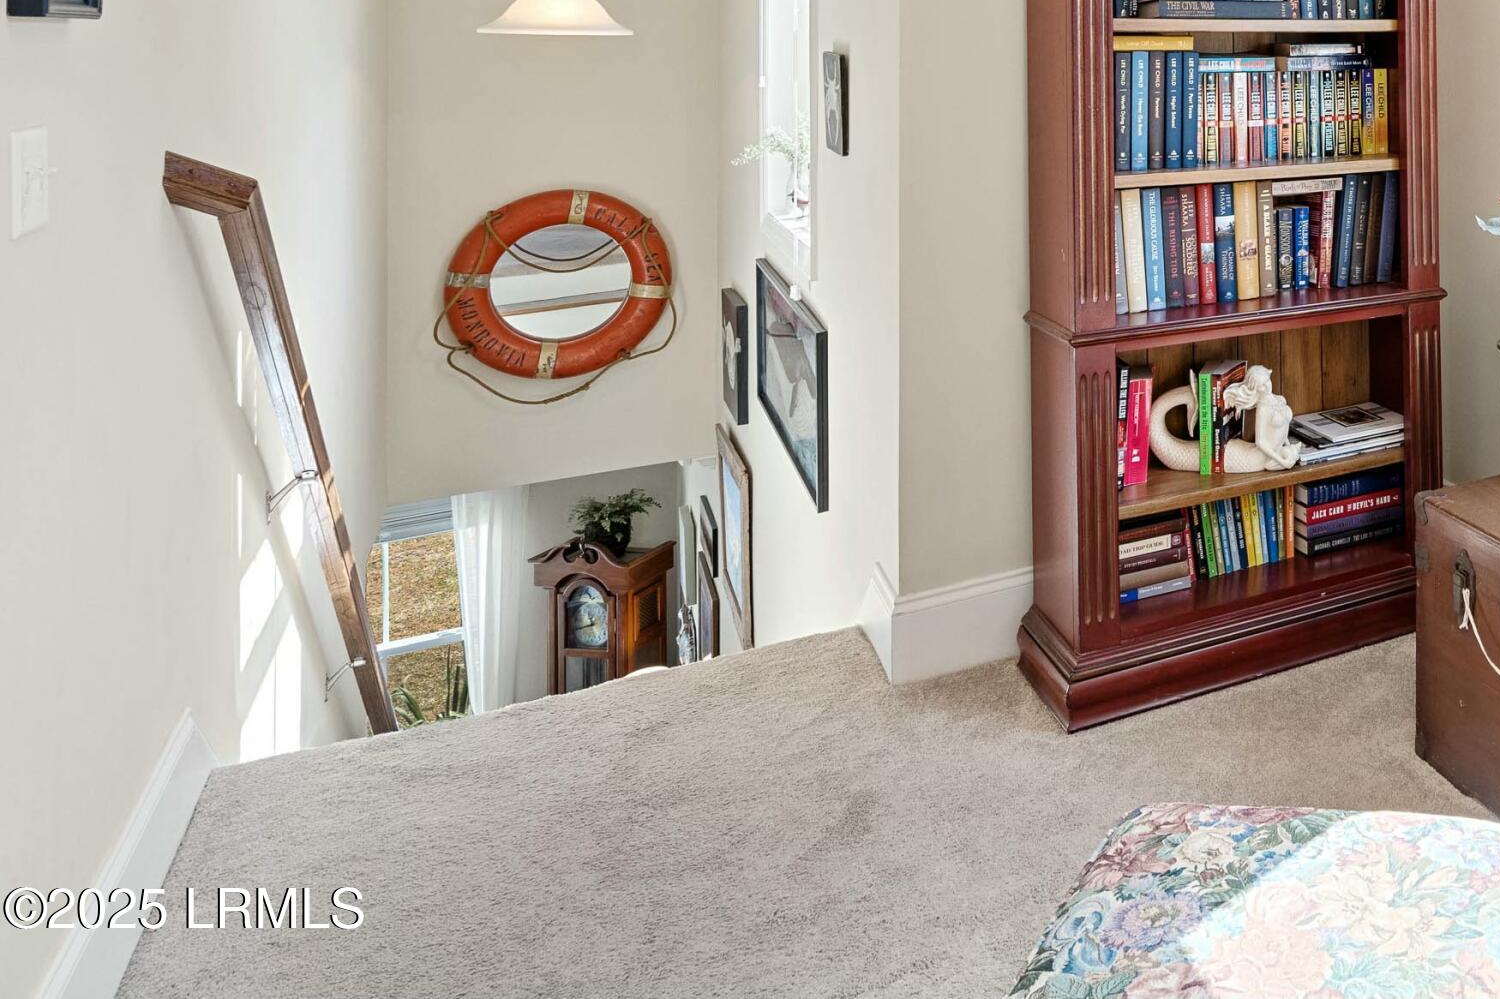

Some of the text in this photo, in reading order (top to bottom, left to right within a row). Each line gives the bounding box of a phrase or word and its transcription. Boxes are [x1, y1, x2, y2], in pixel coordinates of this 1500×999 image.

[1167, 2, 1215, 10] THE CIVIL WAR
[1181, 194, 1189, 226] SHAARA
[1279, 221, 1292, 254] MONSOON
[1185, 237, 1193, 275] SOLDIERS
[1120, 370, 1128, 388] KILLING
[1119, 400, 1127, 418] KILLERS
[1312, 495, 1391, 520] JACK CARR DEVIL'S HAND
